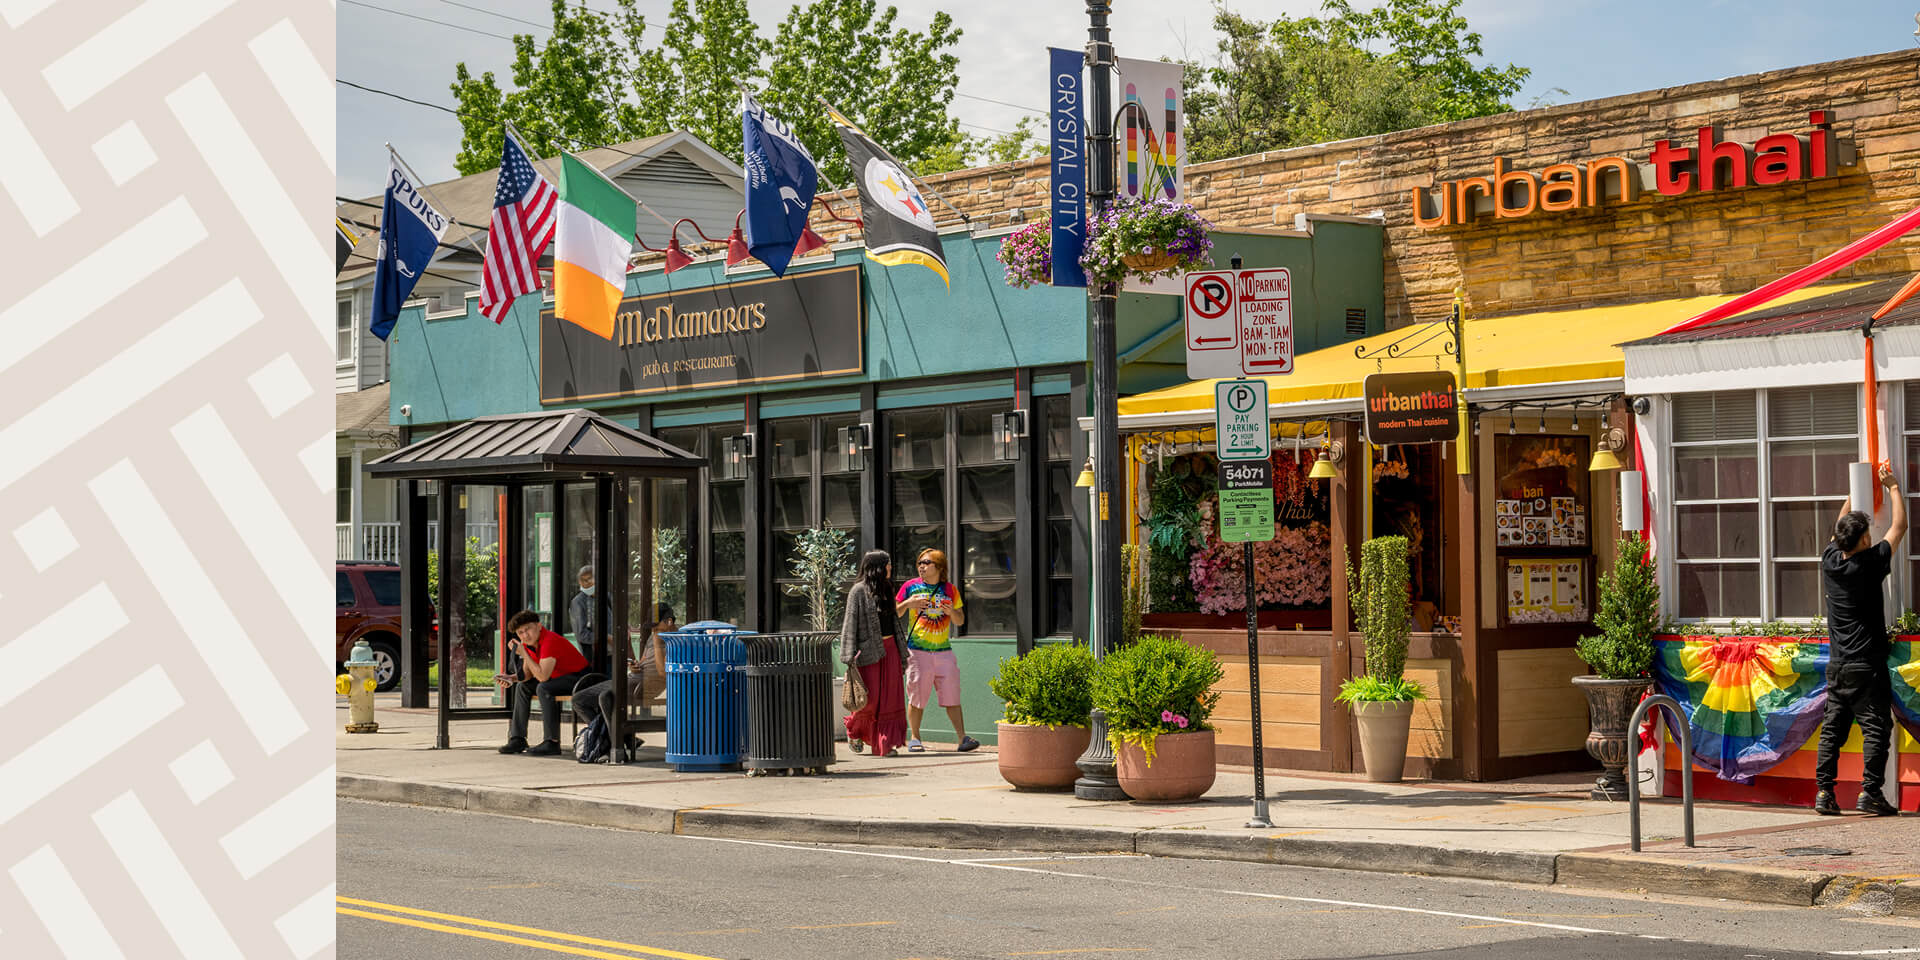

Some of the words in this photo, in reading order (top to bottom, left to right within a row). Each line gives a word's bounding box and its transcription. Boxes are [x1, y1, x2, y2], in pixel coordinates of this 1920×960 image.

[1057, 73, 1078, 175] CRYSTAL
[1412, 157, 1637, 229] urban
[1649, 109, 1836, 197] thai
[391, 168, 445, 232] SPURS
[1058, 182, 1079, 236] CITY
[1240, 276, 1254, 297] NO
[1255, 278, 1287, 292] PARKING
[1245, 301, 1283, 313] LOADING
[1252, 314, 1277, 326] ZONE
[1243, 326, 1263, 340] 8AM
[1270, 325, 1289, 340] 11AM
[1245, 342, 1267, 356] MON
[1274, 341, 1289, 355] FRI
[642, 360, 661, 380] pub
[1236, 389, 1248, 409] P
[1234, 414, 1250, 424] PAY
[1378, 420, 1406, 429] modern
[1407, 418, 1423, 427] Thai
[1423, 417, 1449, 426] cuisine
[1226, 423, 1259, 433] PARKING
[1230, 433, 1239, 447] 2
[1225, 467, 1264, 480] 54071
[1234, 480, 1264, 488] ParkMobile
